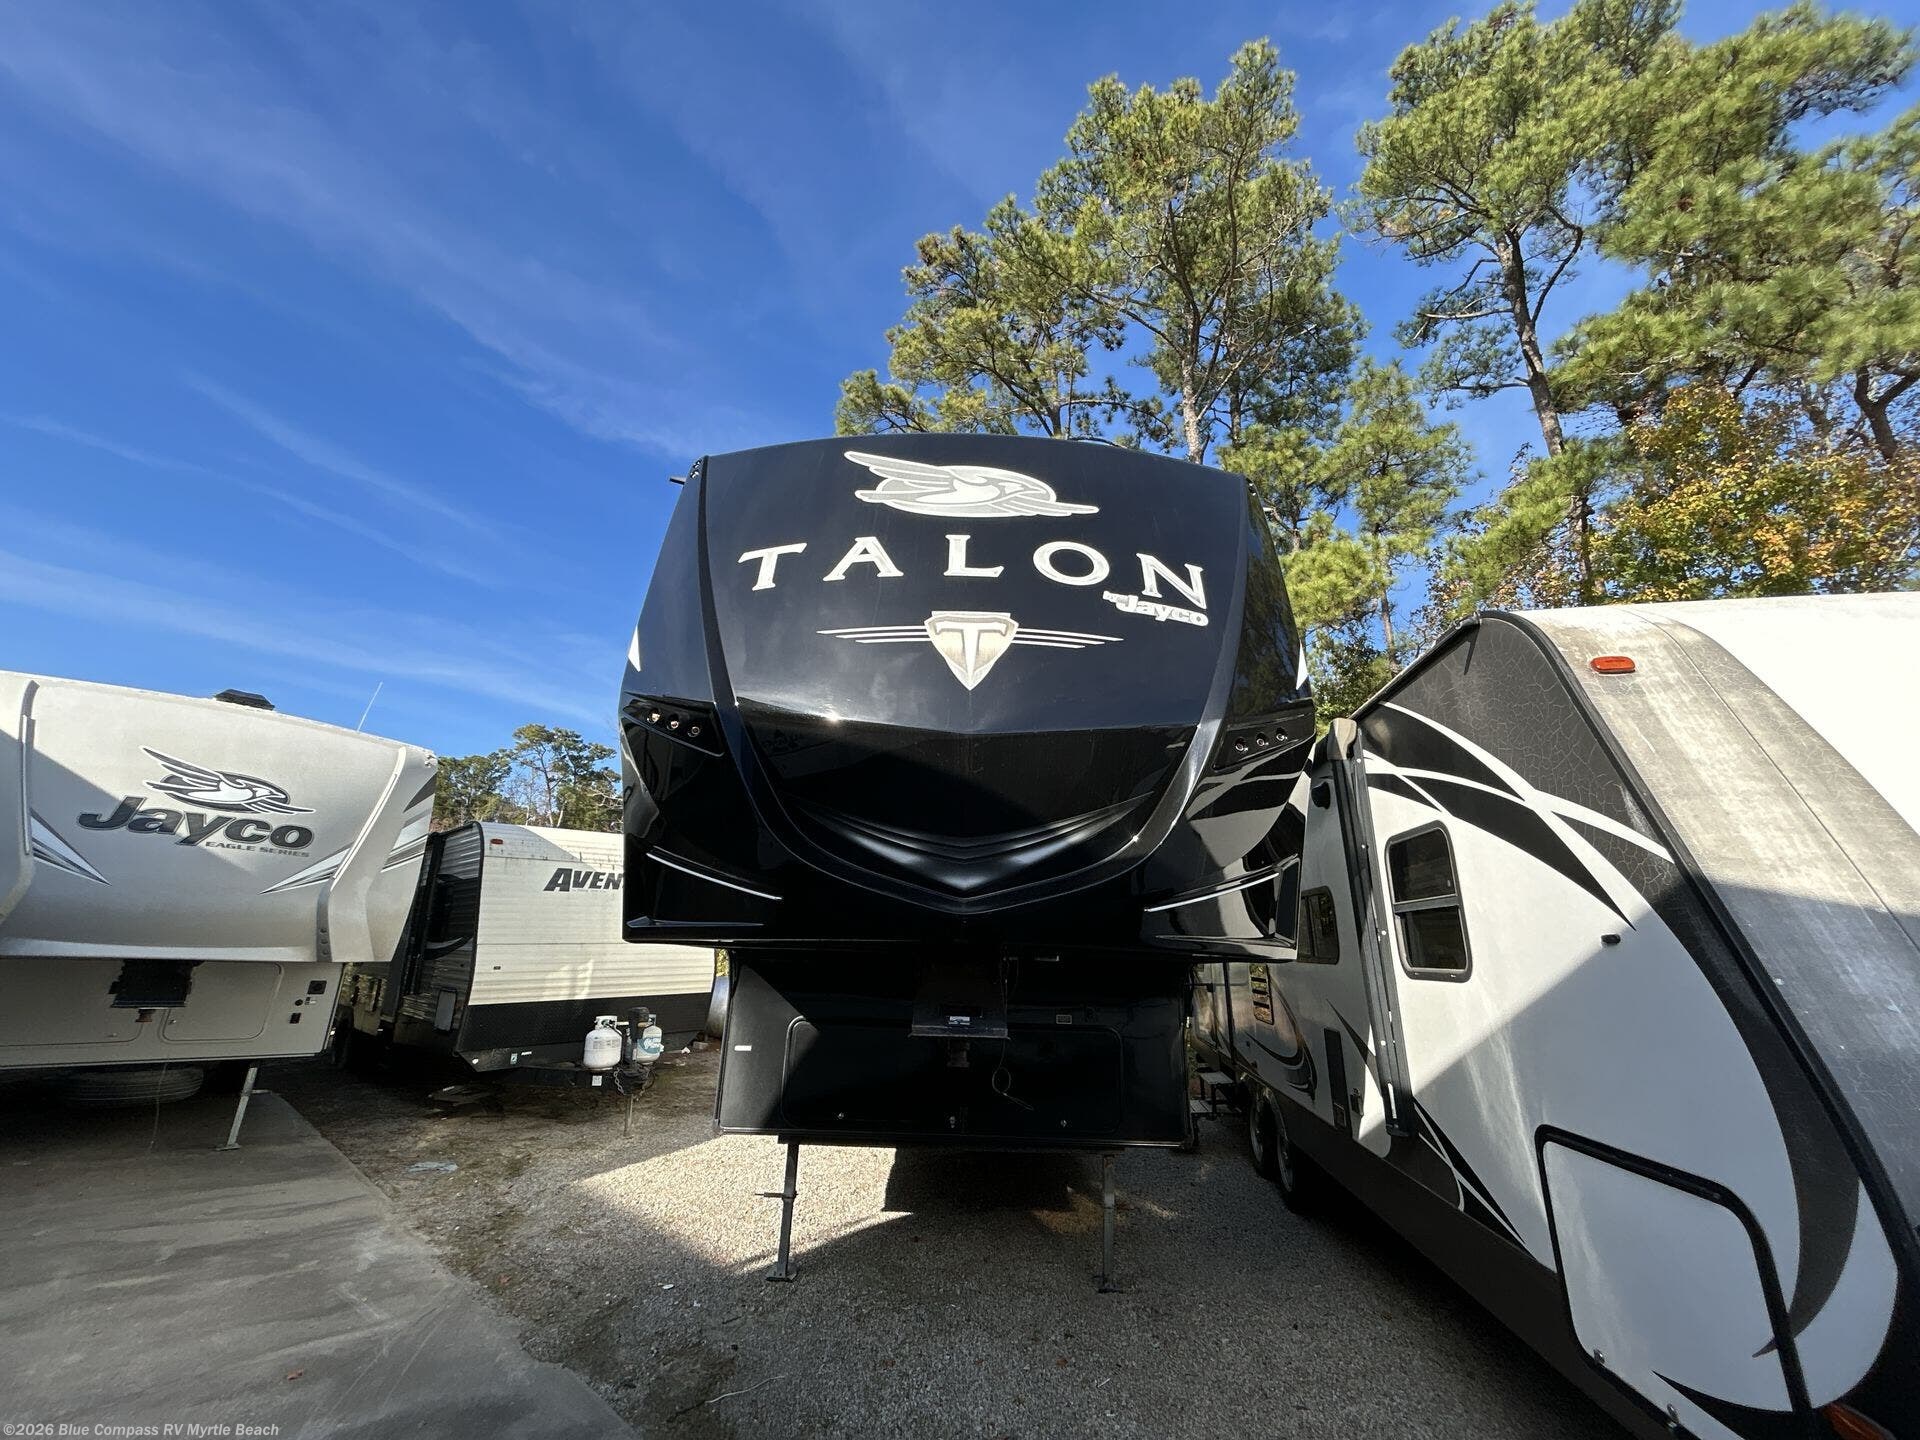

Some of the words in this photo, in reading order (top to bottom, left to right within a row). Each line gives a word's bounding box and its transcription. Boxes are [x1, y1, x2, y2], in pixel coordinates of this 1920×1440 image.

[738, 534, 1207, 609] TALON
[1116, 595, 1208, 626] Jayco
[935, 621, 1007, 680] T
[78, 795, 314, 849] Jayco
[205, 841, 256, 852] EAGLE
[260, 847, 310, 858] SERIES
[543, 867, 624, 892] AVEN
